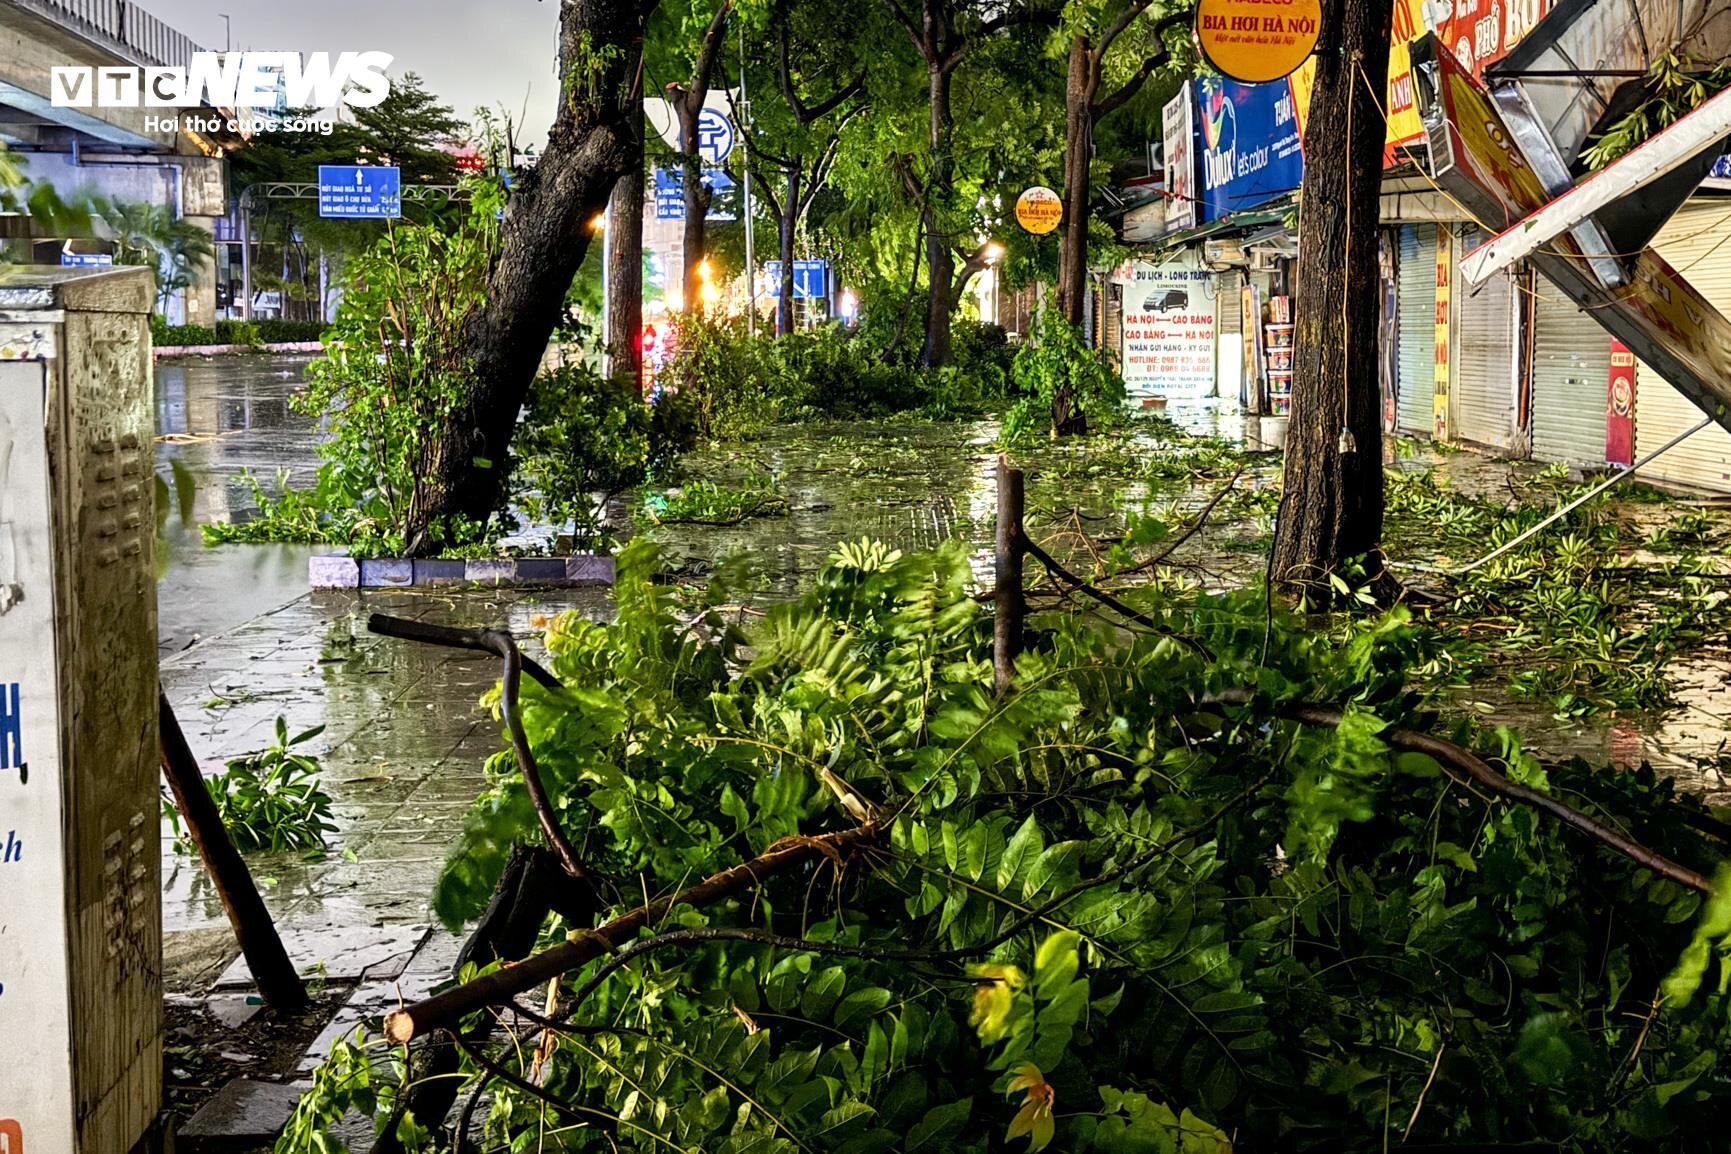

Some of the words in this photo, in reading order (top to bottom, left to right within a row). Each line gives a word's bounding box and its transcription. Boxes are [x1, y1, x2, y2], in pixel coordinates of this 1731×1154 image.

[1203, 15, 1227, 30] BIA
[1231, 16, 1259, 32] HƠI
[1263, 14, 1284, 33] HÀ
[1288, 15, 1316, 37] NỘI
[1271, 35, 1281, 45] Hà
[1283, 36, 1296, 46] Nội
[1391, 75, 1412, 113] ANH
[1204, 145, 1234, 191] Dulux
[1238, 152, 1249, 177] let's
[1249, 145, 1269, 173] colour
[1136, 271, 1147, 281] DU
[1148, 271, 1163, 282] LỊCH
[1169, 271, 1188, 281] LONG
[1172, 314, 1189, 325] CAO
[1125, 330, 1141, 339] CAO
